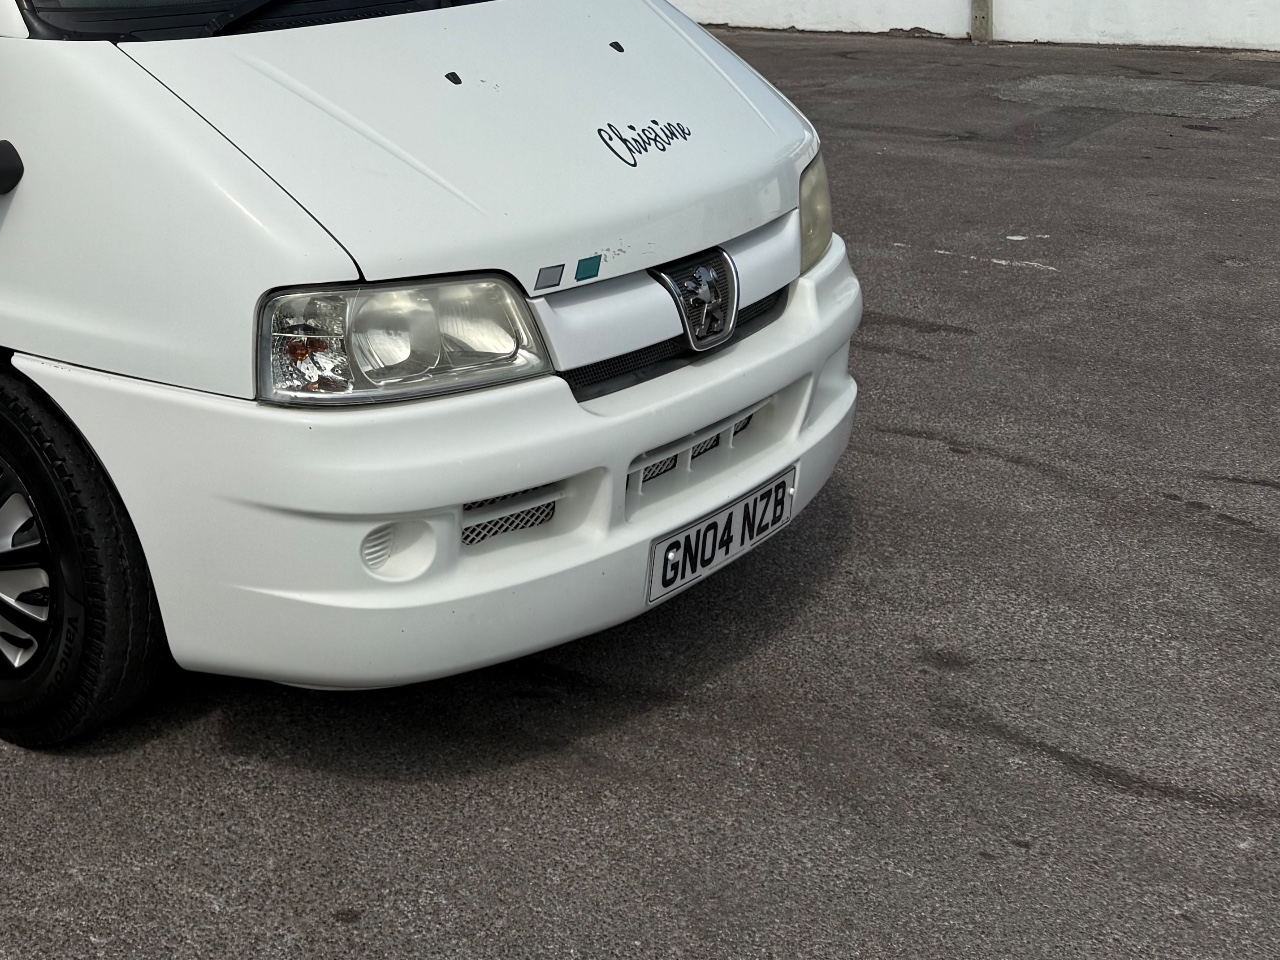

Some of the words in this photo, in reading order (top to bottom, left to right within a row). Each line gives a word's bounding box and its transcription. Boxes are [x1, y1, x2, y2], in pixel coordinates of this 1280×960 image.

[597, 119, 691, 167] Christine
[662, 511, 734, 588] GN04
[740, 480, 787, 547] NZB
